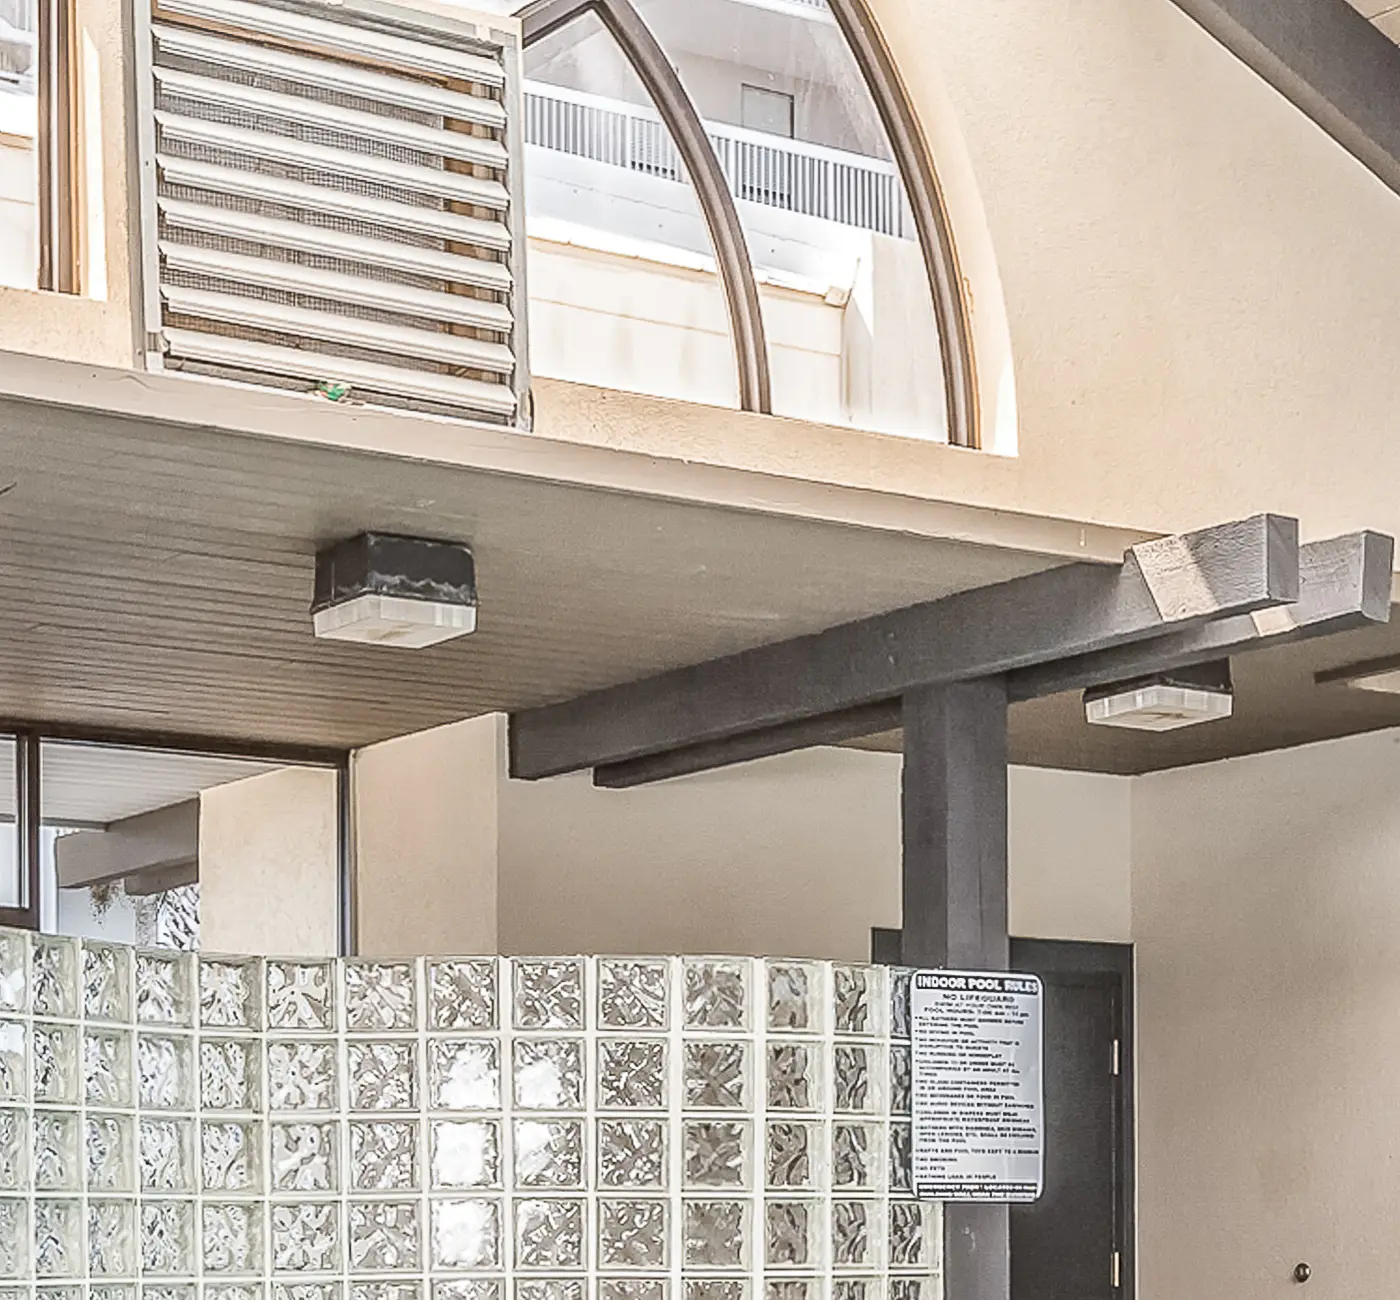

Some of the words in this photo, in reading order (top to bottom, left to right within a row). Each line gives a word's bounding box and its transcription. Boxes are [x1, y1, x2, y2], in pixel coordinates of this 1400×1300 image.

[918, 976, 966, 989] INDOOR
[968, 978, 1002, 990] POOL
[1004, 980, 1038, 992] RULES
